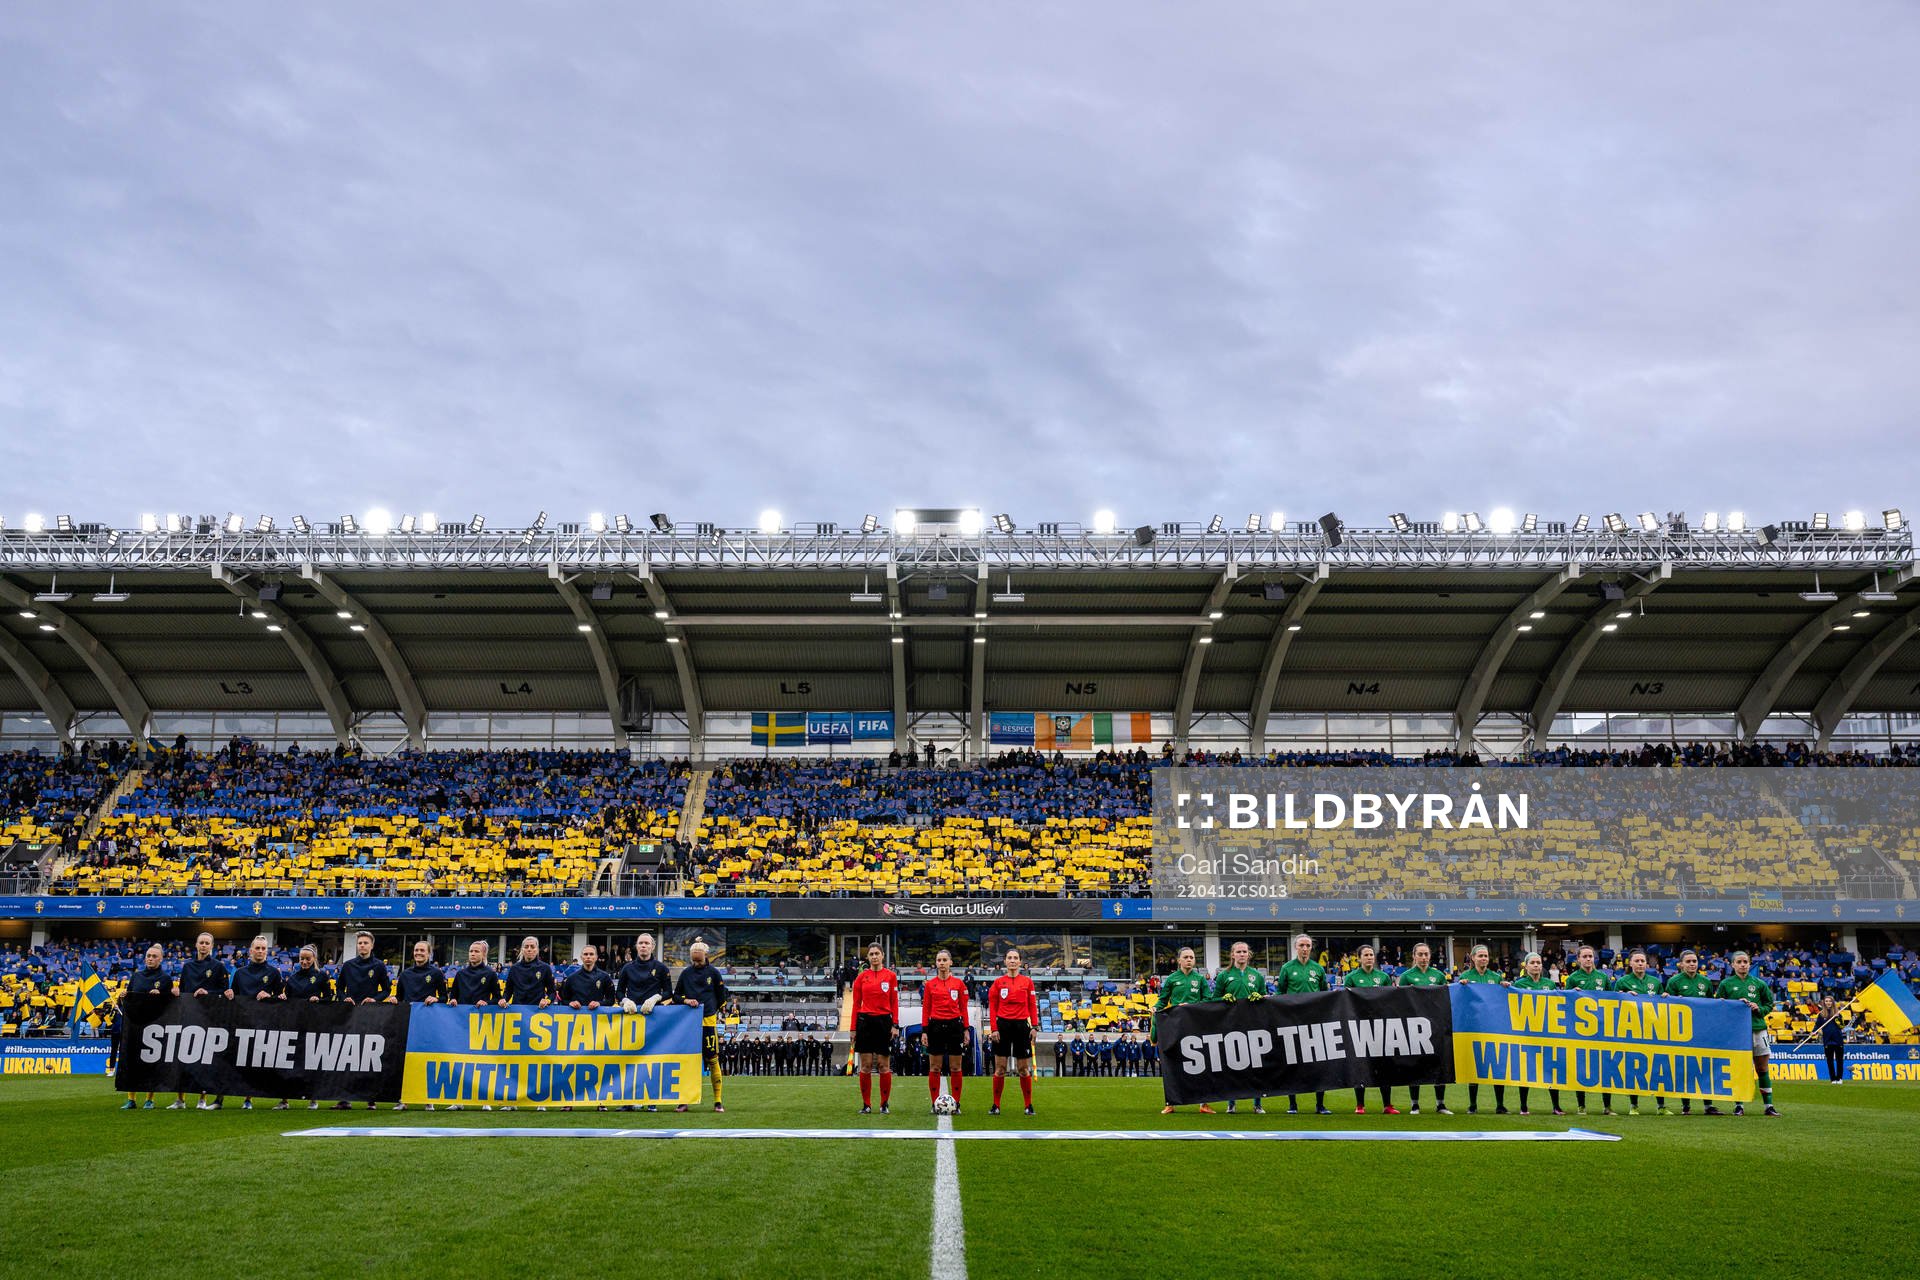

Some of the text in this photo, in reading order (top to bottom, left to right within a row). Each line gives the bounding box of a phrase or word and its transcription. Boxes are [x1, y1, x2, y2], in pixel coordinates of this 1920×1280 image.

[221, 682, 253, 694] L3
[500, 682, 532, 694] L4
[780, 682, 811, 694] L5
[1065, 682, 1096, 694] N5
[1347, 682, 1380, 695] N4
[1630, 682, 1664, 695] N3
[810, 723, 849, 734] UEFA
[858, 720, 889, 731] FIFA
[1002, 725, 1034, 733] RESPECT
[919, 903, 1004, 915] Gamla Ullevi
[1508, 993, 1693, 1042] WE STAND
[469, 1011, 646, 1051] WE STAND
[140, 1024, 386, 1072] STOP THE WAR
[706, 1035, 716, 1049] 17
[1180, 1016, 1435, 1075] STOP THE WAR
[4, 1058, 71, 1074] UKRAINA
[1472, 1041, 1733, 1096] WITH UKRAINE
[1764, 1063, 1818, 1080] RAINA
[1852, 1063, 1893, 1080] STÖD
[426, 1061, 681, 1101] WITH UKRAINE
